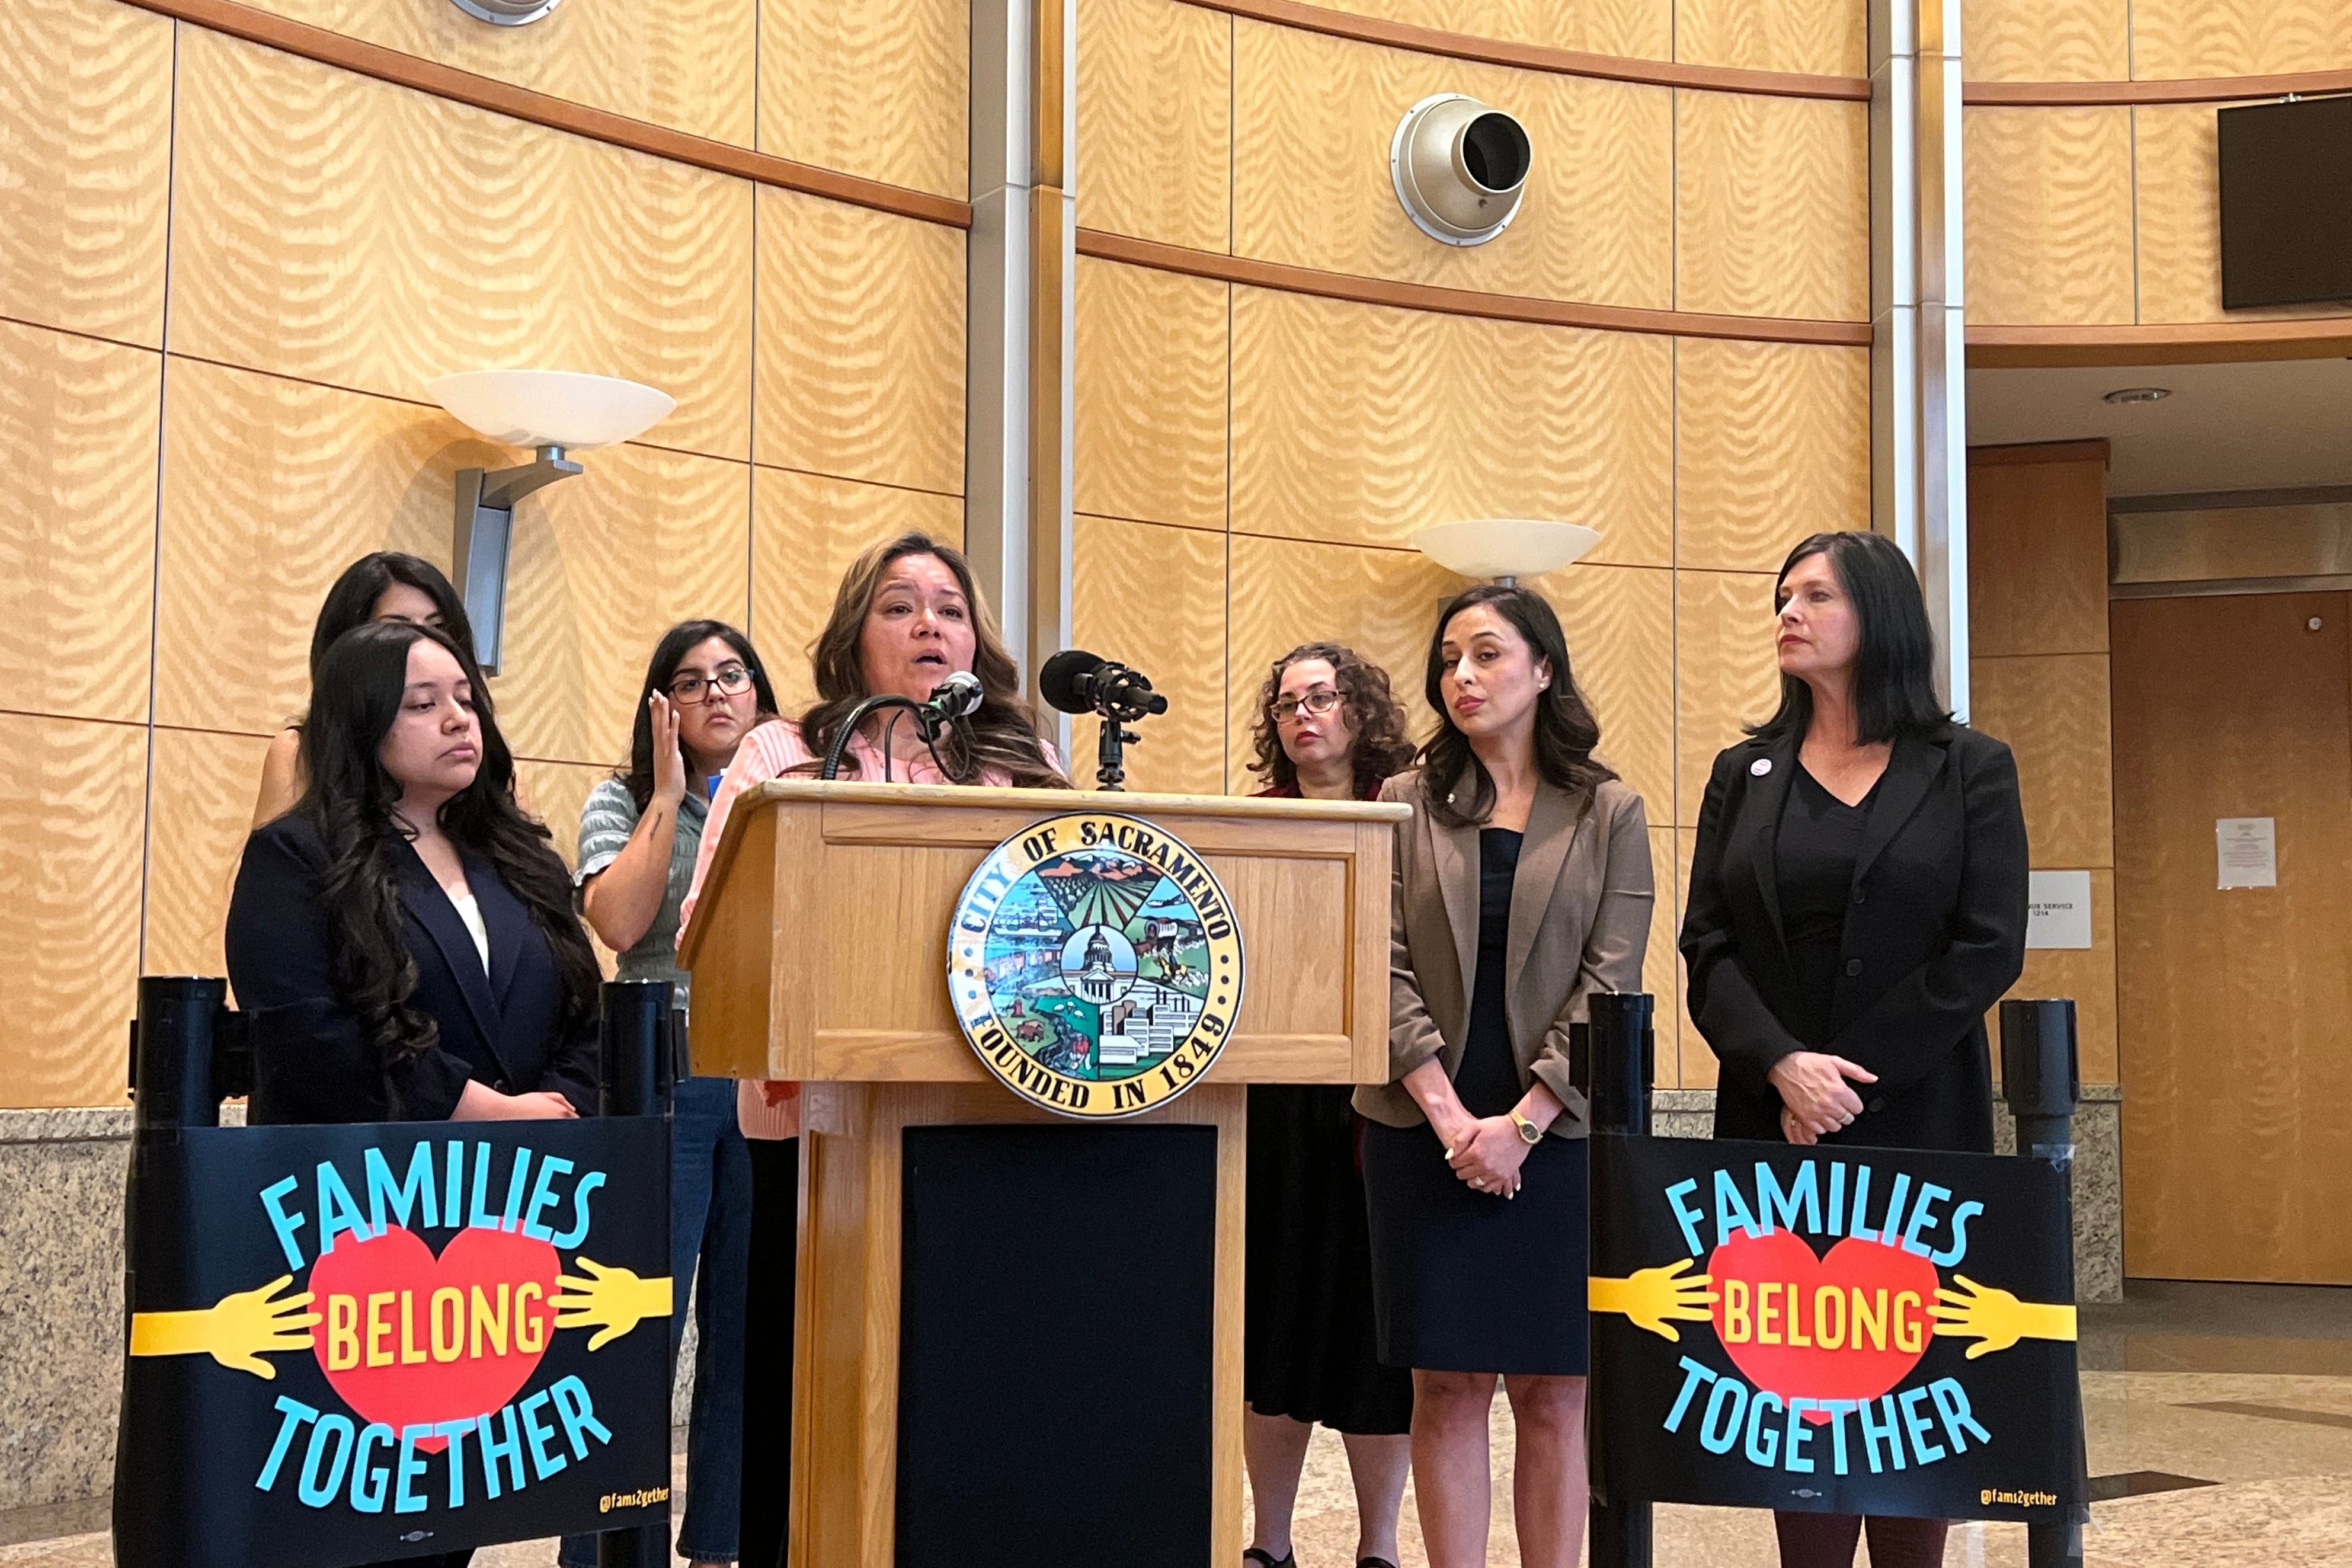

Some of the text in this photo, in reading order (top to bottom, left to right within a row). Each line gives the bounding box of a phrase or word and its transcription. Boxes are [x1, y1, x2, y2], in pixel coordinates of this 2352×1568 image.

[961, 821, 1232, 941] CITY OF SACRAMENTO
[969, 1013, 1225, 1109] FOUNDED IN 1849
[260, 1140, 607, 1272] FAMILIES
[1665, 1160, 1984, 1268] FAMILIES
[328, 1282, 543, 1371] BELONG
[1724, 1279, 1922, 1353] BELONG
[255, 1374, 613, 1514] TOGETHER
[1663, 1355, 1992, 1475] TOGETHER
[600, 1487, 669, 1513] @fams2gether
[1980, 1489, 2057, 1507] @fams2gether
